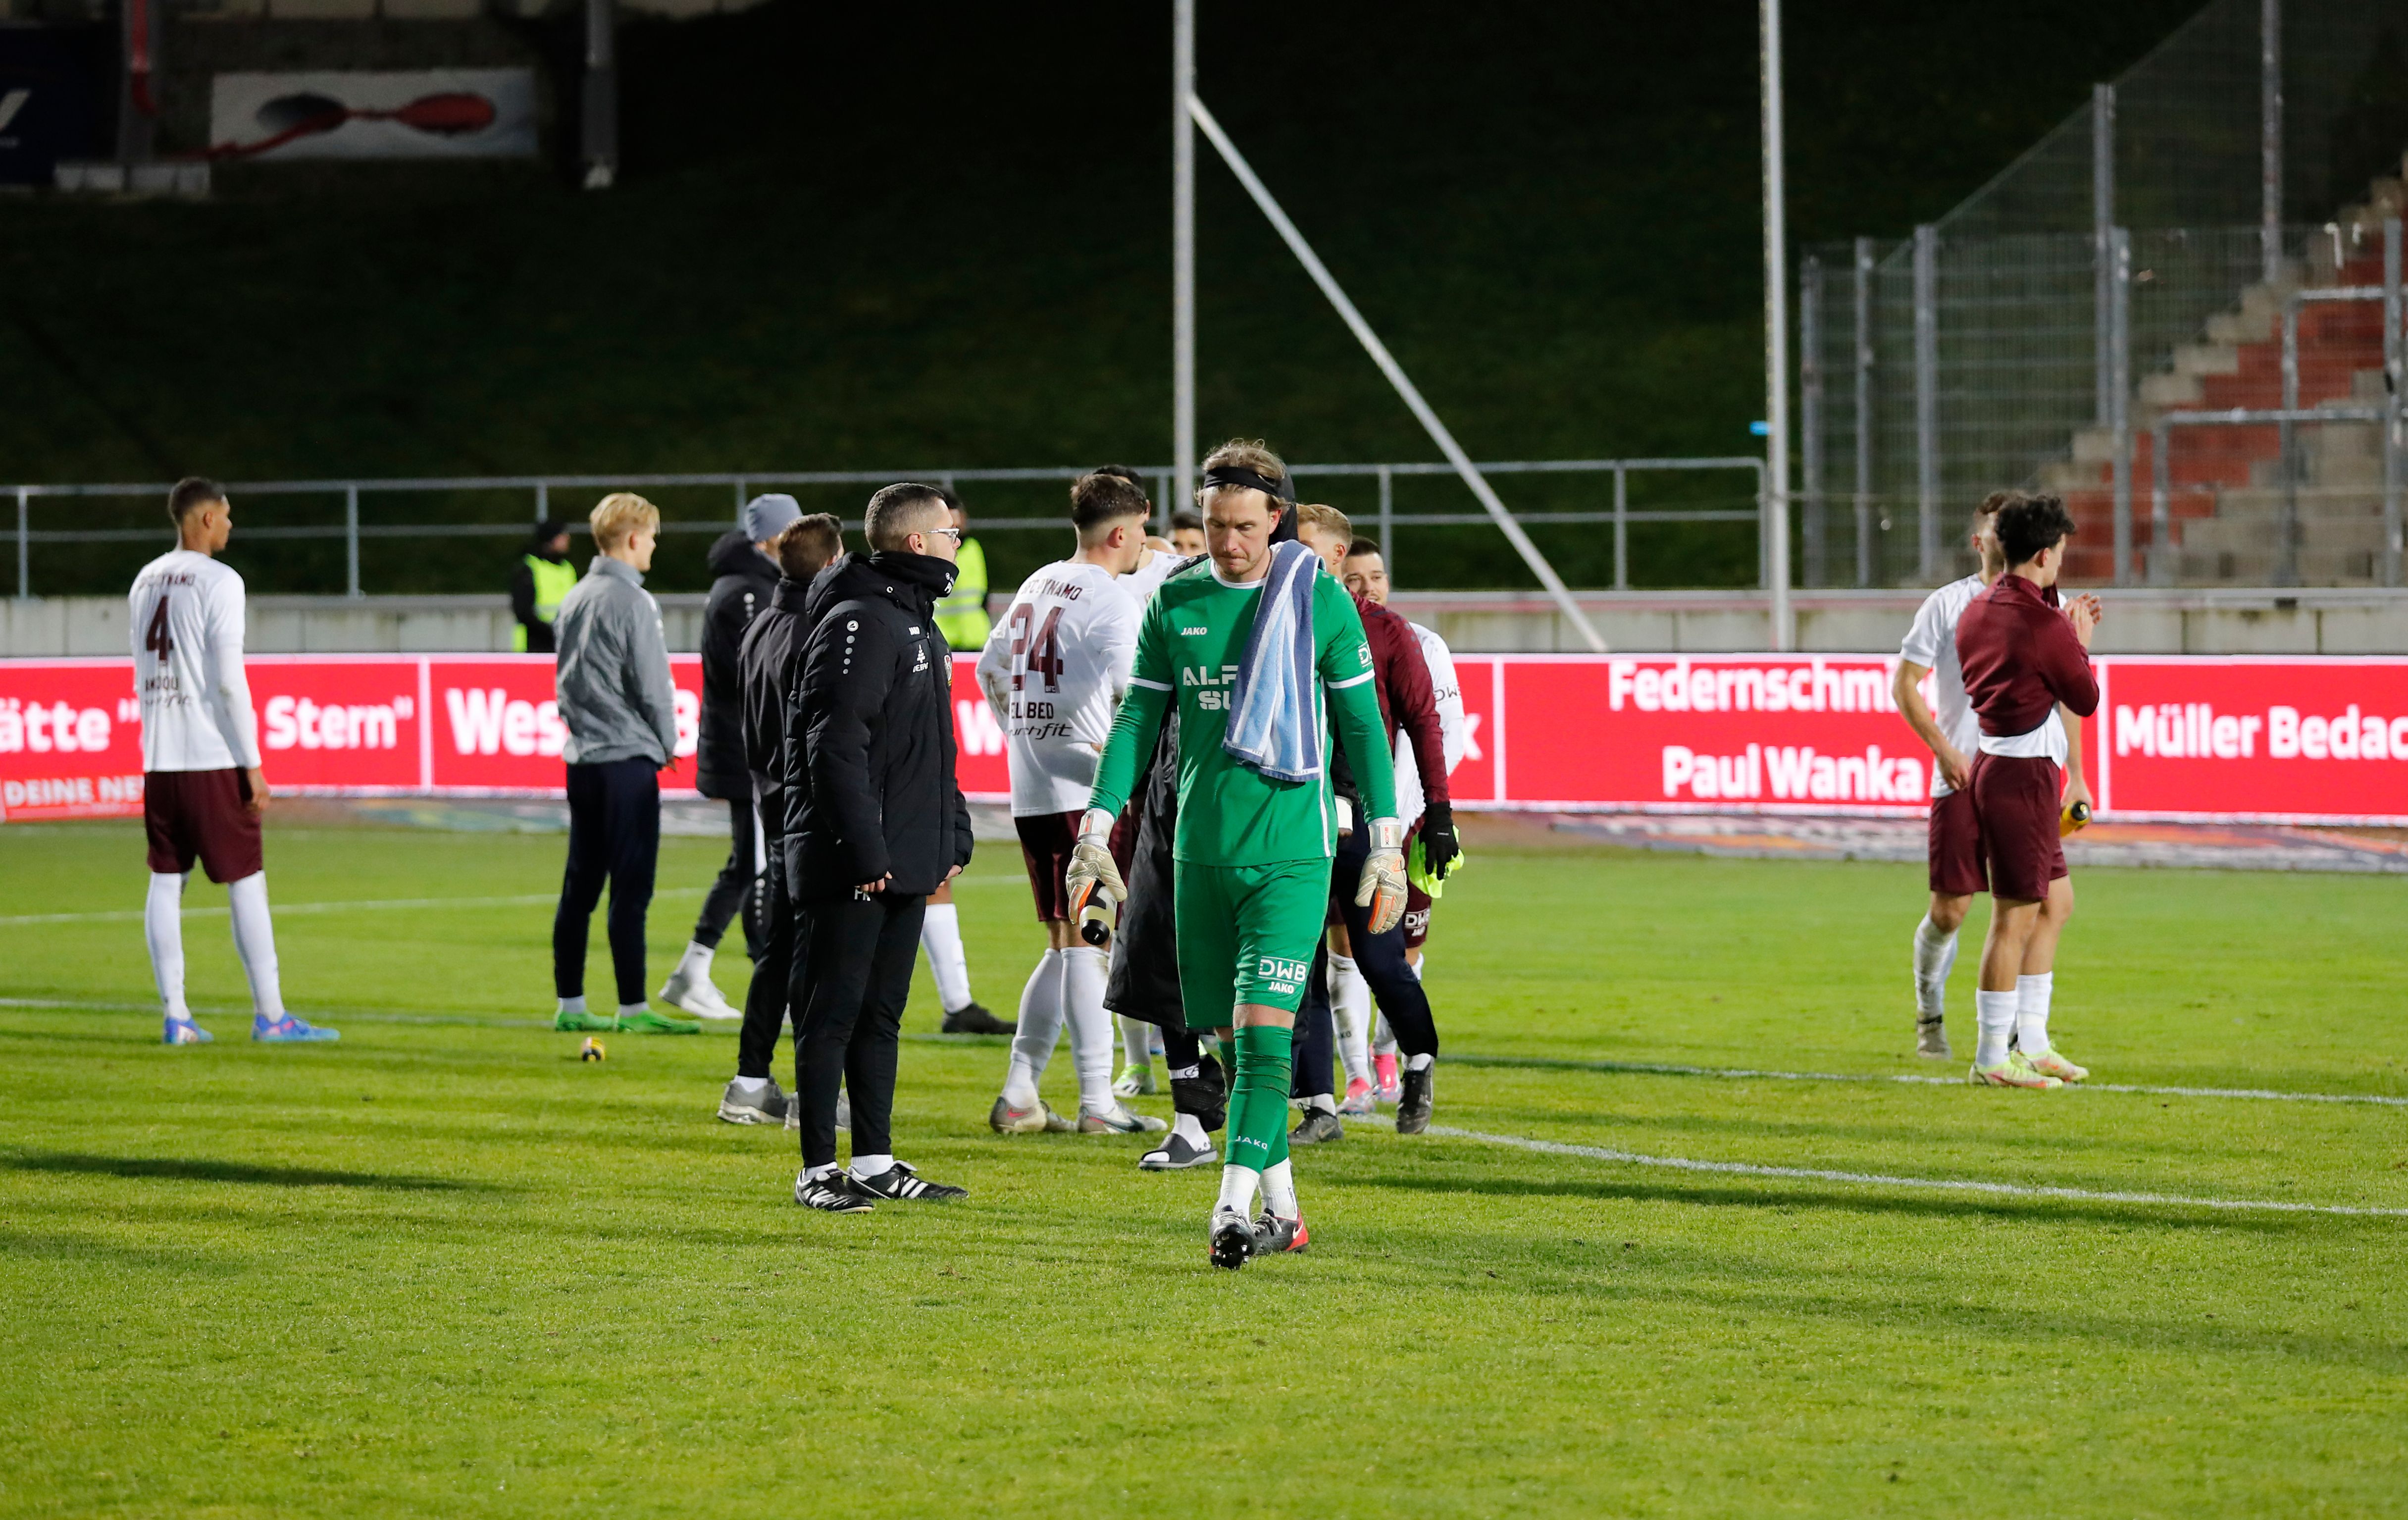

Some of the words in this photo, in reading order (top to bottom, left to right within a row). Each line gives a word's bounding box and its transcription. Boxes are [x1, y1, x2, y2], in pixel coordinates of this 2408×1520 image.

[146, 596, 173, 660] 4
[1181, 627, 1207, 635] JAKO
[1010, 603, 1065, 692] 24
[1608, 656, 1937, 713] Federnschmi
[1026, 702, 1054, 719] BED
[2115, 703, 2261, 758] Müller
[1662, 744, 1761, 798] Paul
[1764, 744, 1923, 801] Wanka
[4, 777, 93, 807] DEINE
[99, 775, 145, 803] NE
[1258, 959, 1306, 981] DWB
[1269, 981, 1294, 994] JAKO
[1235, 1136, 1267, 1150] JAKO
